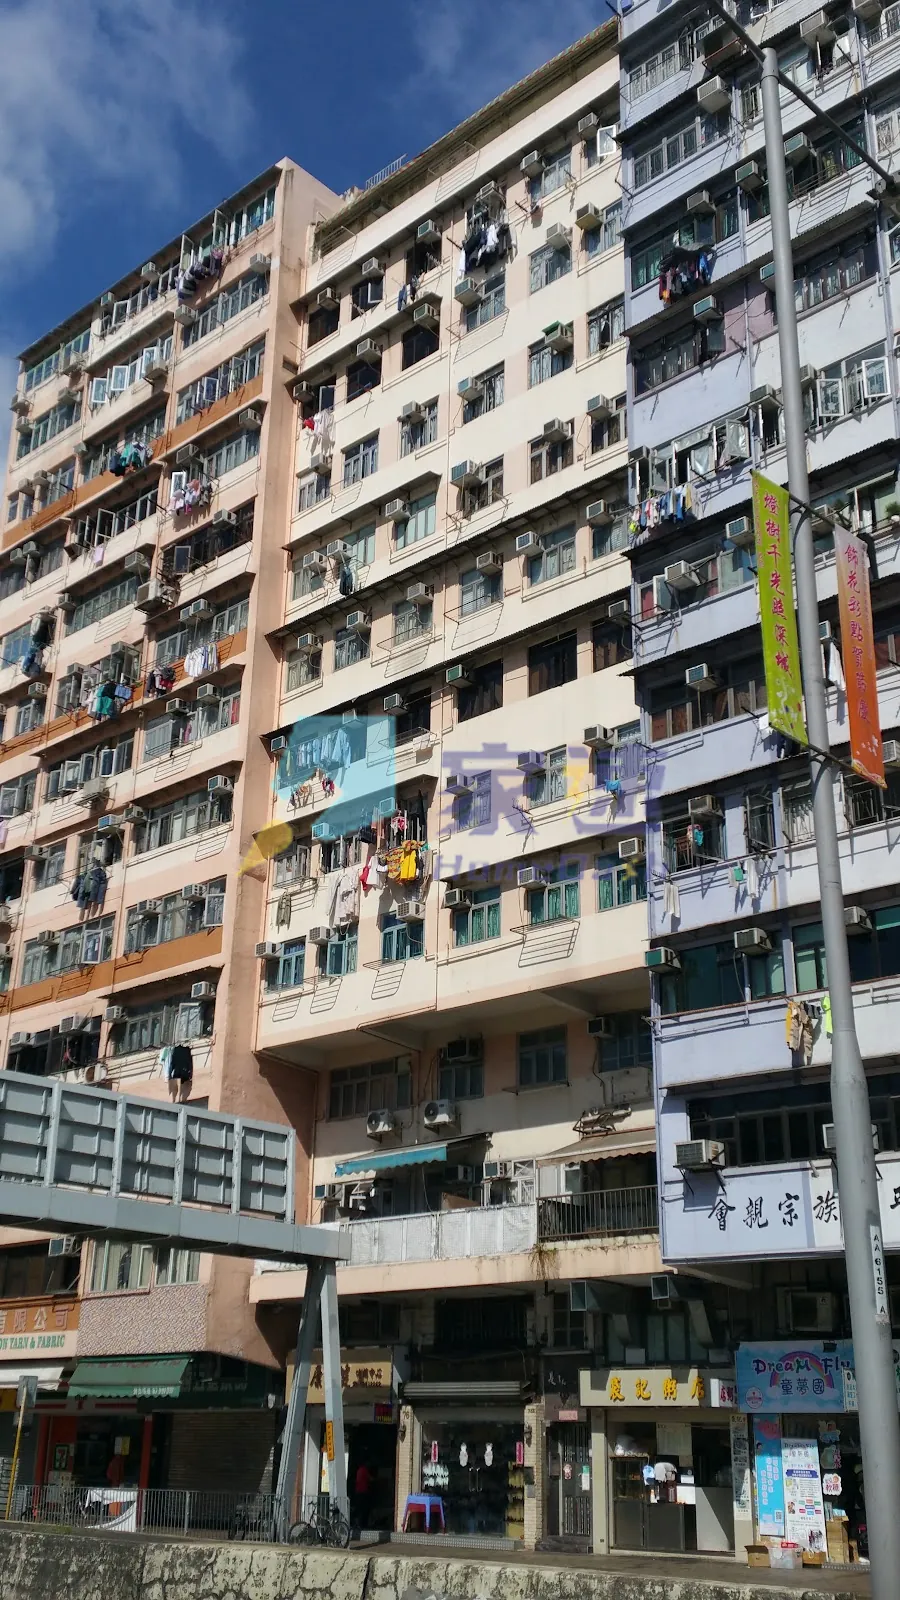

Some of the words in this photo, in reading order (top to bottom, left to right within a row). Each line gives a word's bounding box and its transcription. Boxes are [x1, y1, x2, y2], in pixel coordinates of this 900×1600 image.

[9, 1336, 30, 1350] YARN
[37, 1334, 66, 1349] FABRIC
[780, 1378, 825, 1395] 童夢國
